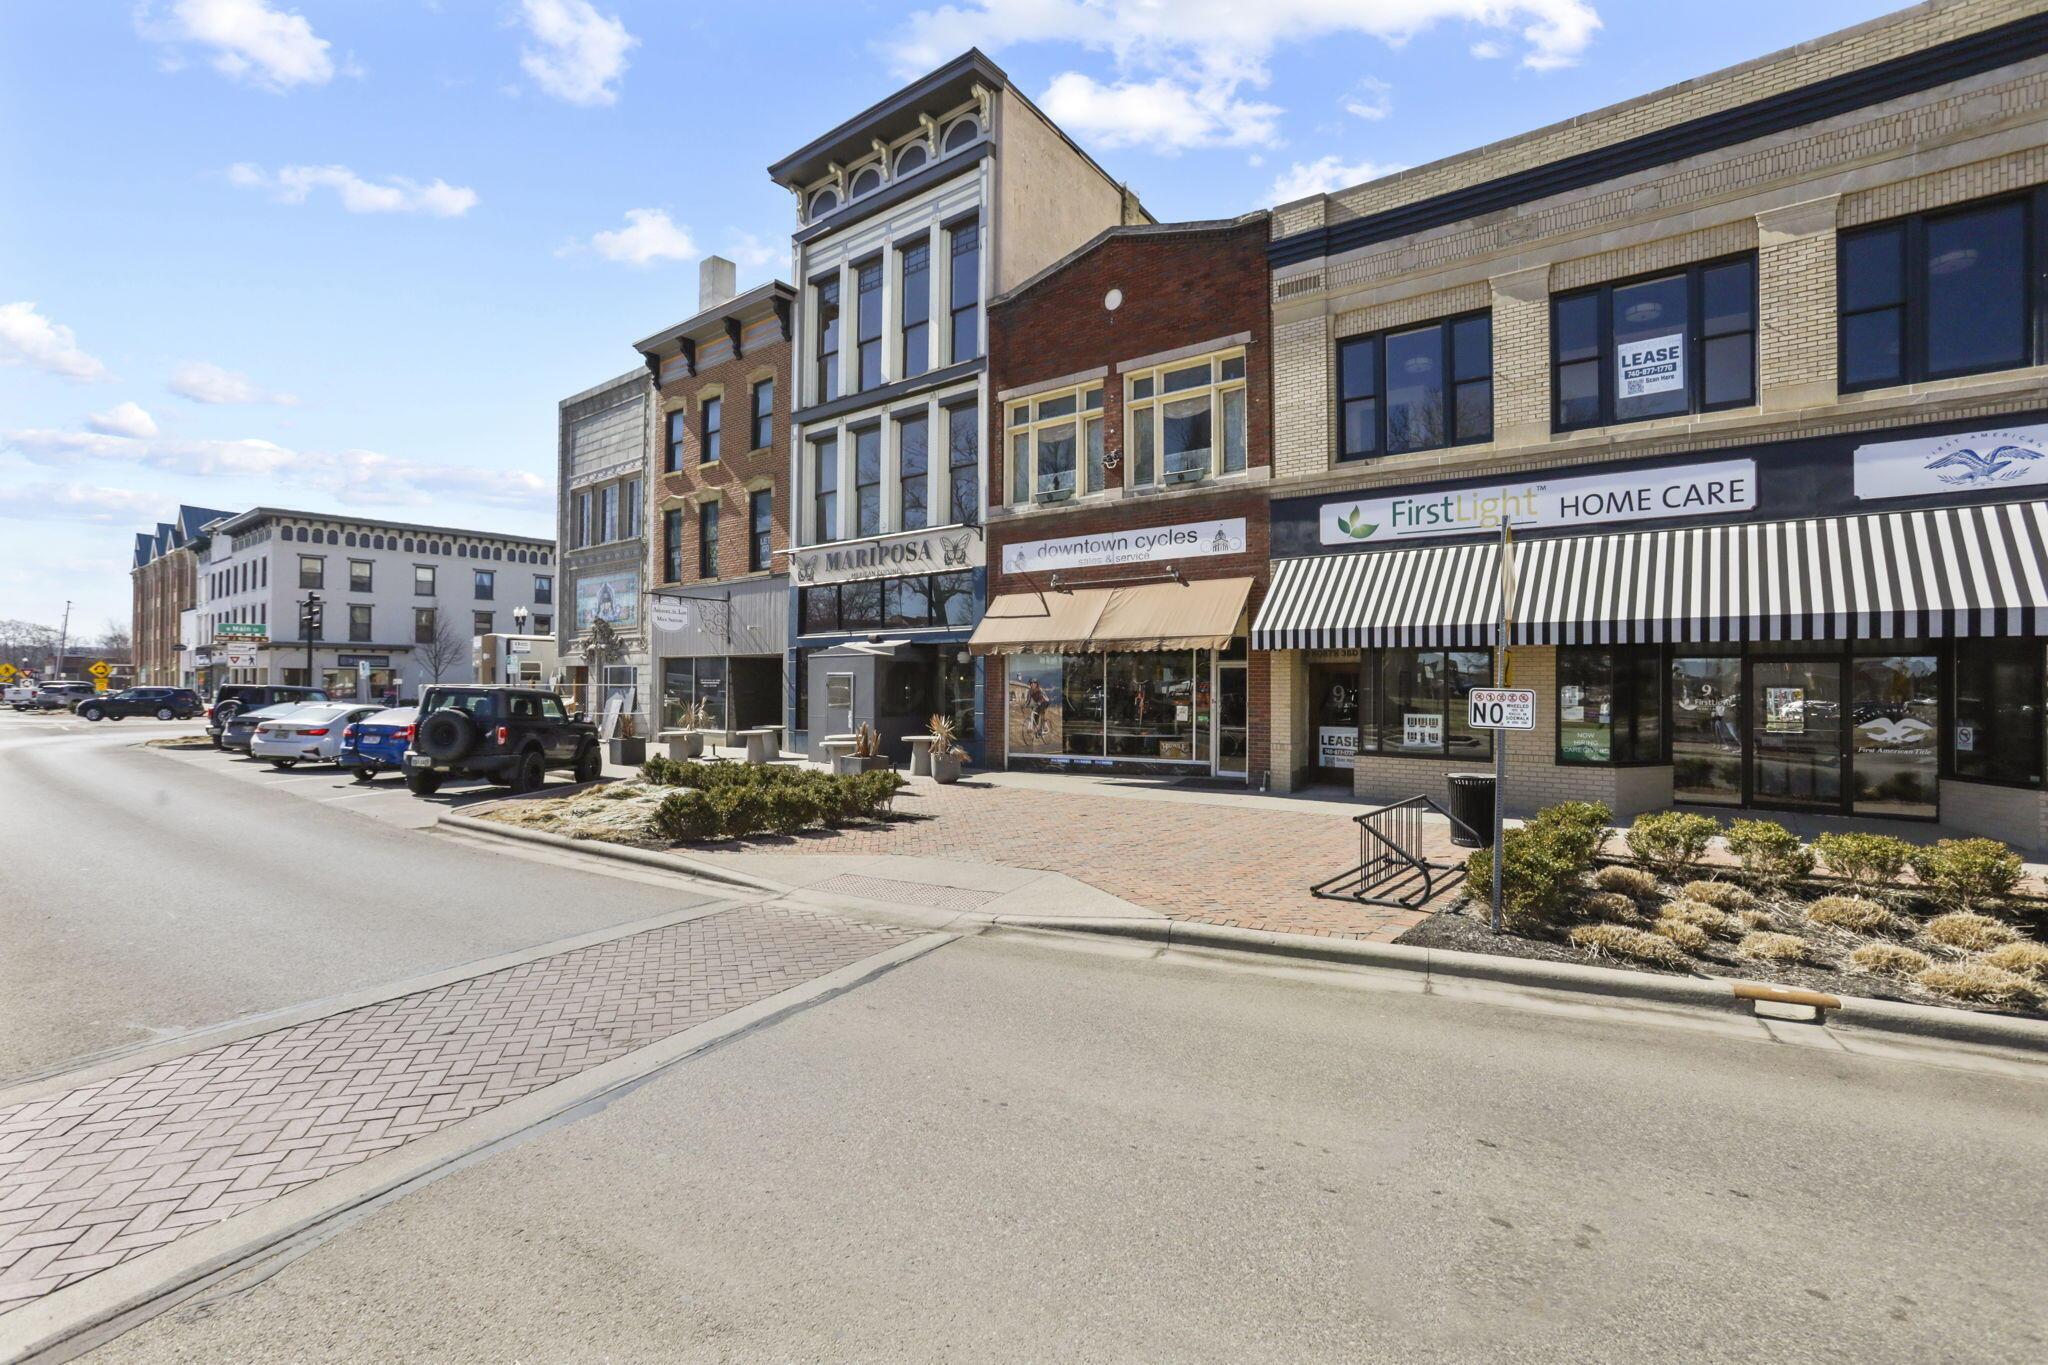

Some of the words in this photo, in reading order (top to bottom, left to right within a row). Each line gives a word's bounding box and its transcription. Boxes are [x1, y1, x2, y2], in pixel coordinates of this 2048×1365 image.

[1622, 345, 1680, 368] LEASE
[1646, 376, 1660, 384] Scan
[1926, 438, 1959, 460] FIRST
[1970, 432, 2043, 448] AMERICAN
[1391, 487, 1539, 529] FirstLight
[1560, 488, 1652, 518] HOME
[1662, 478, 1745, 508] CARE
[1037, 536, 1129, 558] downtown
[1134, 529, 1198, 551] cycles
[826, 539, 933, 572] MARIPOSA
[1078, 556, 1103, 566] sales
[1105, 555, 1112, 564] &
[1115, 552, 1150, 563] service
[1701, 684, 1712, 697] 9
[1473, 702, 1504, 724] NO
[1321, 735, 1359, 747] LEASE
[1877, 747, 1914, 755] American
